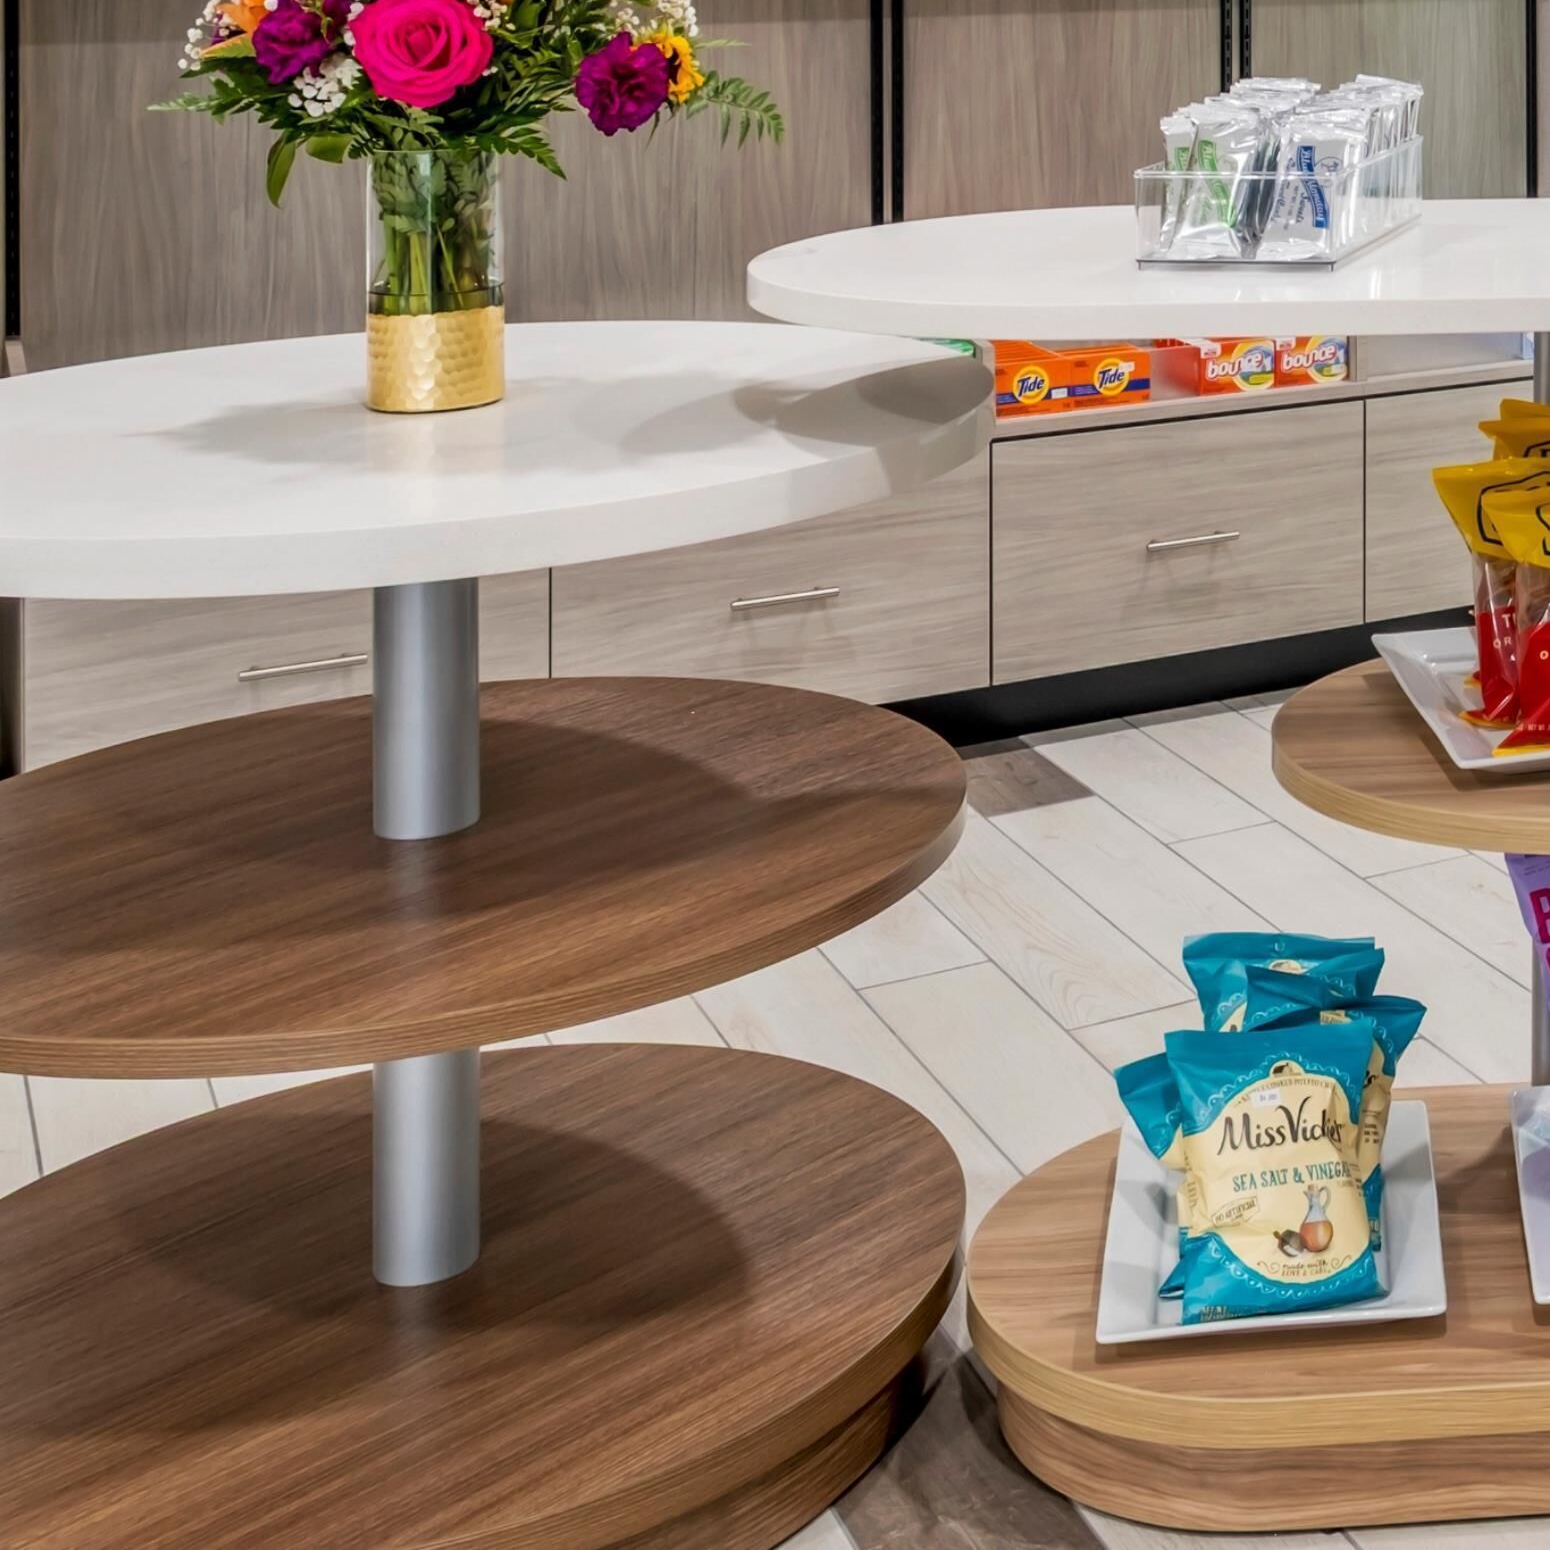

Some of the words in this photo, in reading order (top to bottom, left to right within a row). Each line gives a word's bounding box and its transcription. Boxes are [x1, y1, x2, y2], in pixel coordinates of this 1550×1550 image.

[1208, 353, 1264, 379] bounce
[1282, 344, 1336, 371] bounce
[1018, 376, 1045, 398] Tide
[1098, 367, 1125, 389] Tide
[1217, 1112, 1287, 1156] Miss
[1232, 1173, 1257, 1193] SEA
[1260, 1168, 1289, 1188] SALT
[1293, 1167, 1304, 1184] &
[1305, 1161, 1350, 1181] VINEGA
